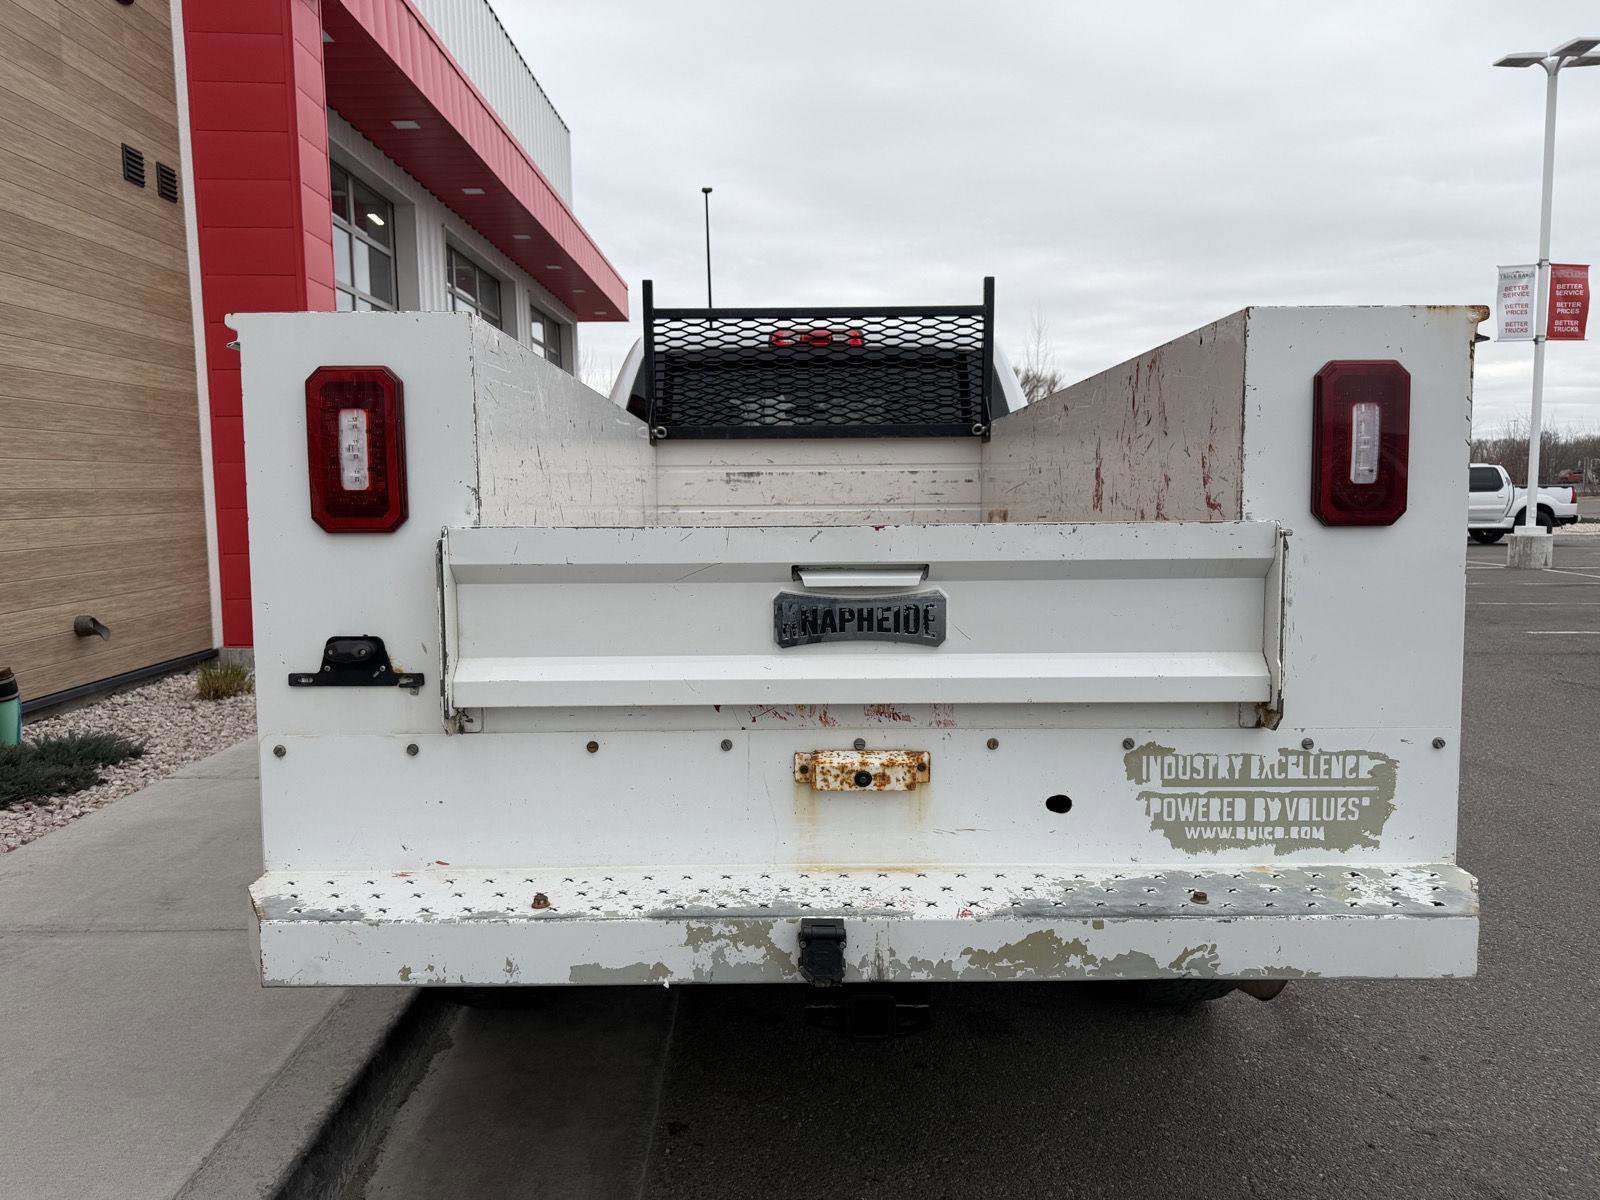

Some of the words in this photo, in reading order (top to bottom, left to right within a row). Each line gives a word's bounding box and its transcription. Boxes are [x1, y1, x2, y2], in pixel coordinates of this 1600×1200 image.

[1142, 755, 1244, 781] INDUSTRY
[1250, 755, 1373, 780] EXCELLENCE
[1149, 797, 1247, 822] POWERED
[1253, 797, 1282, 822] BY
